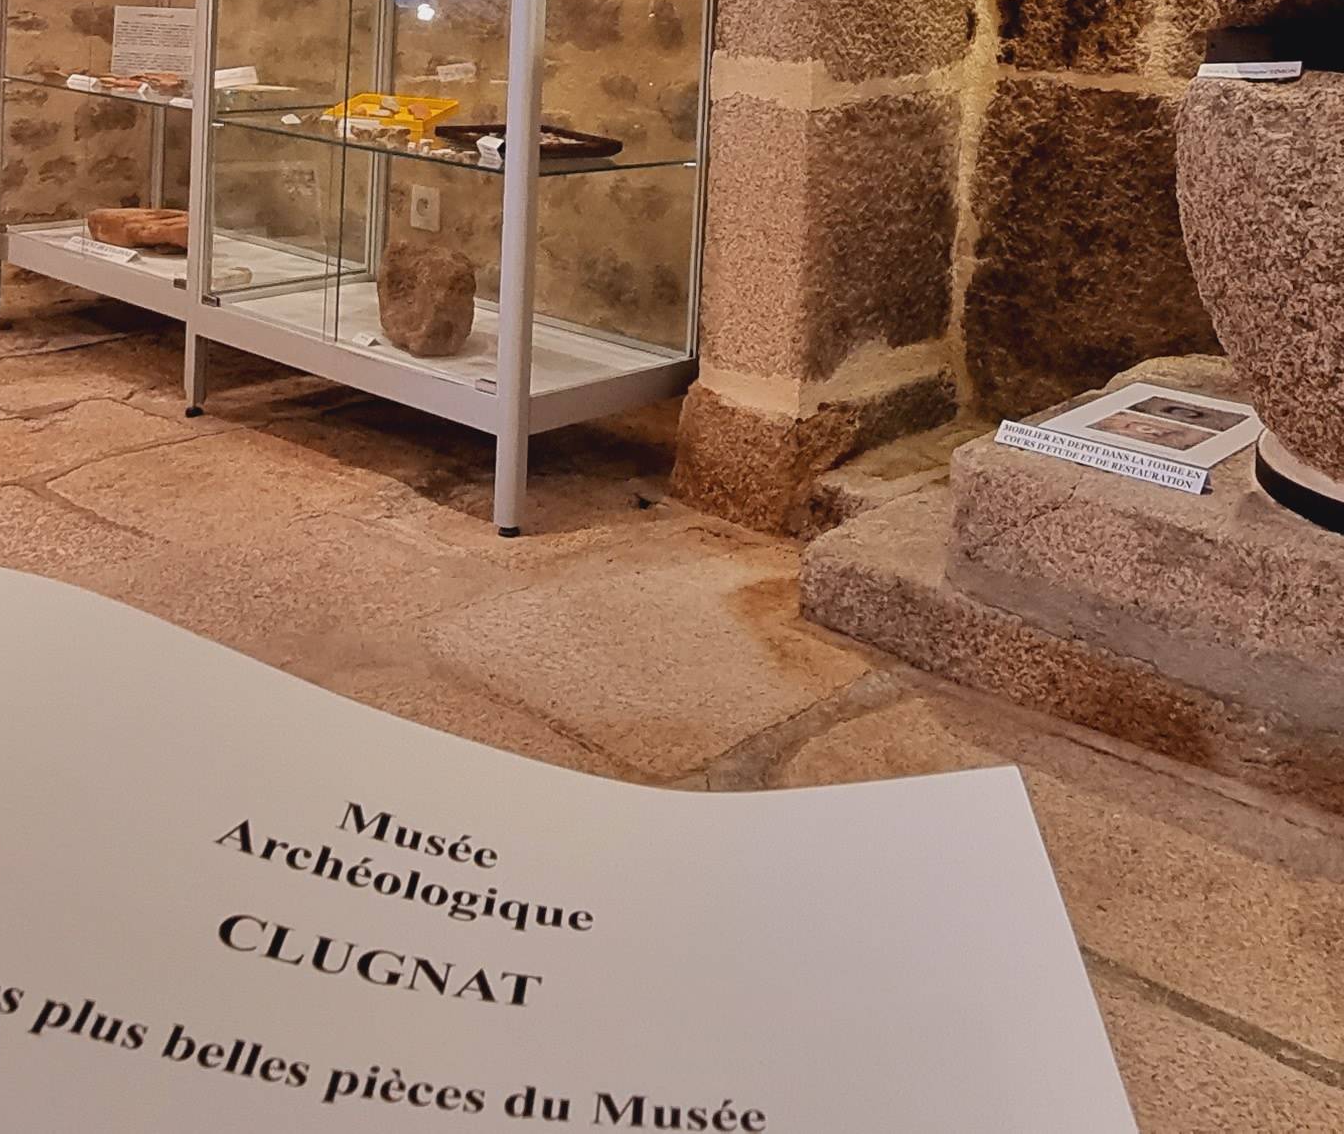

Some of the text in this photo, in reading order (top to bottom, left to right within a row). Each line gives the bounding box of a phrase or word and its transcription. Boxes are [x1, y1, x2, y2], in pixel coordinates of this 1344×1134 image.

[1002, 424, 1203, 479] MOBILIER EN DEPOT DANS LA TOMBE EN
[1003, 434, 1037, 448] COURS
[1080, 454, 1095, 463] ET
[1096, 458, 1109, 467] DE
[1111, 462, 1193, 489] RESTAURATION
[214, 818, 595, 932] Archéologique
[335, 800, 499, 869] Musée
[217, 913, 544, 1007] CLUGNAT
[27, 998, 150, 1050] plus
[161, 1023, 311, 1088] belles
[320, 1065, 487, 1114] pièces
[504, 1085, 573, 1123] du
[592, 1091, 769, 1133] Musée
